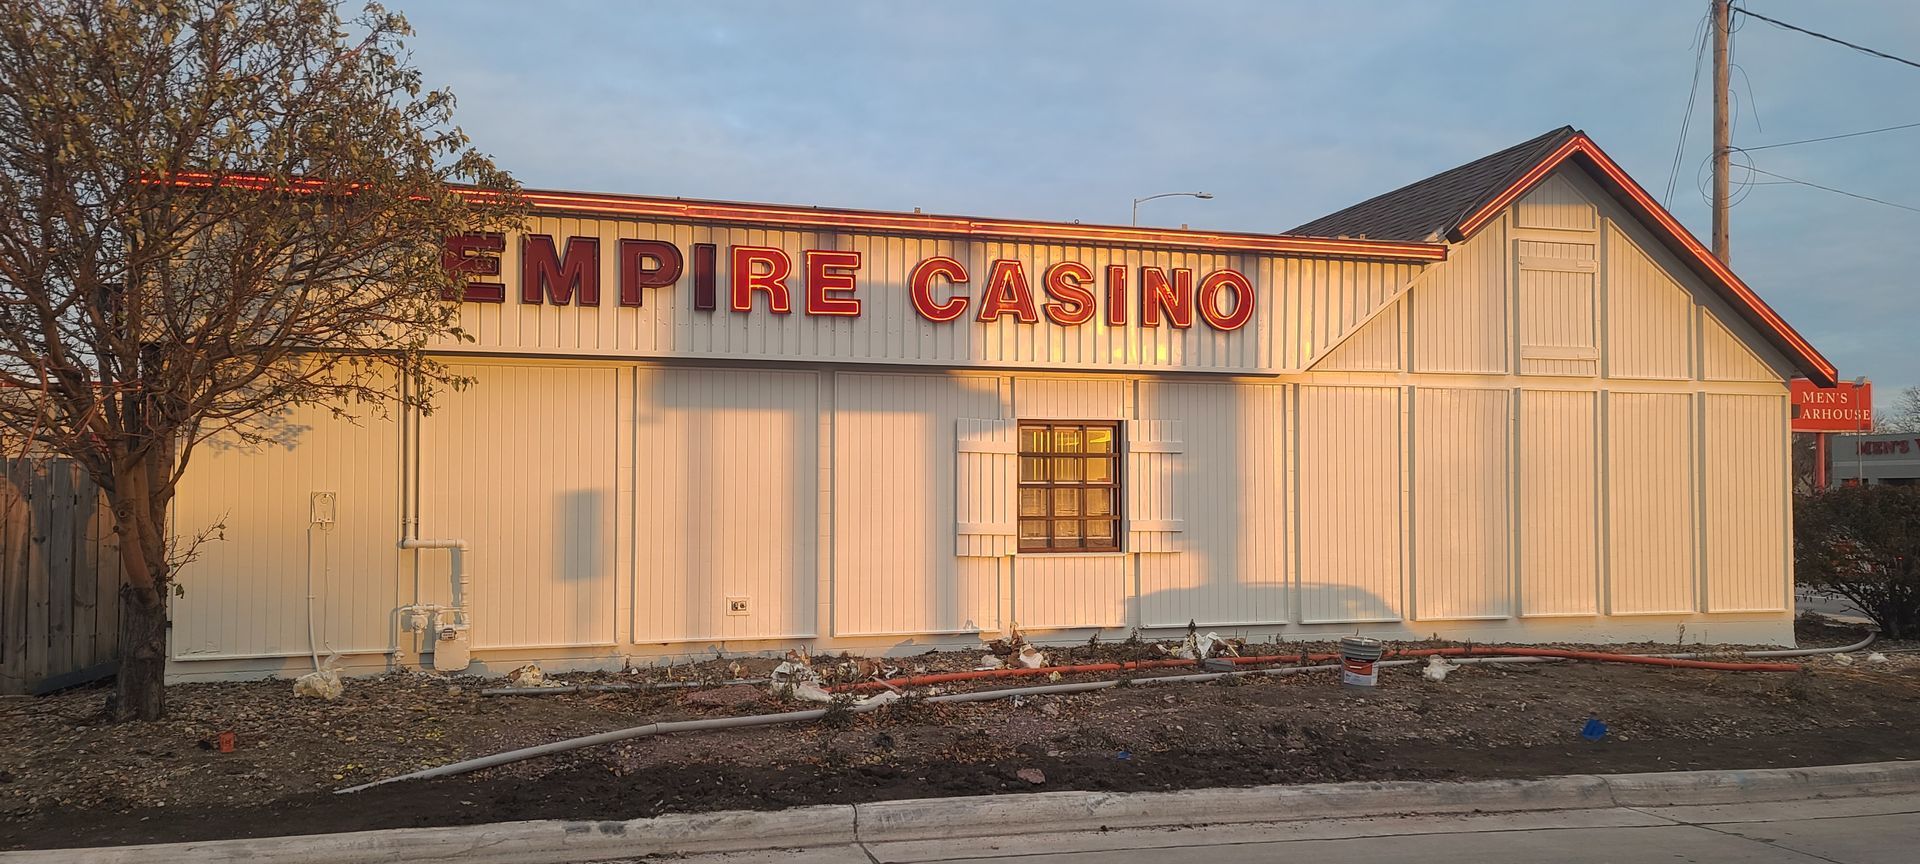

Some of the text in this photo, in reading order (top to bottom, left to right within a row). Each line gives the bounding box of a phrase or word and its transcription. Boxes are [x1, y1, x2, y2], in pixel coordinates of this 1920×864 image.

[440, 230, 1255, 332] EMPIRE CASINO
[1802, 391, 1848, 404] MEN'S
[1800, 408, 1871, 420] ARHOUSE
